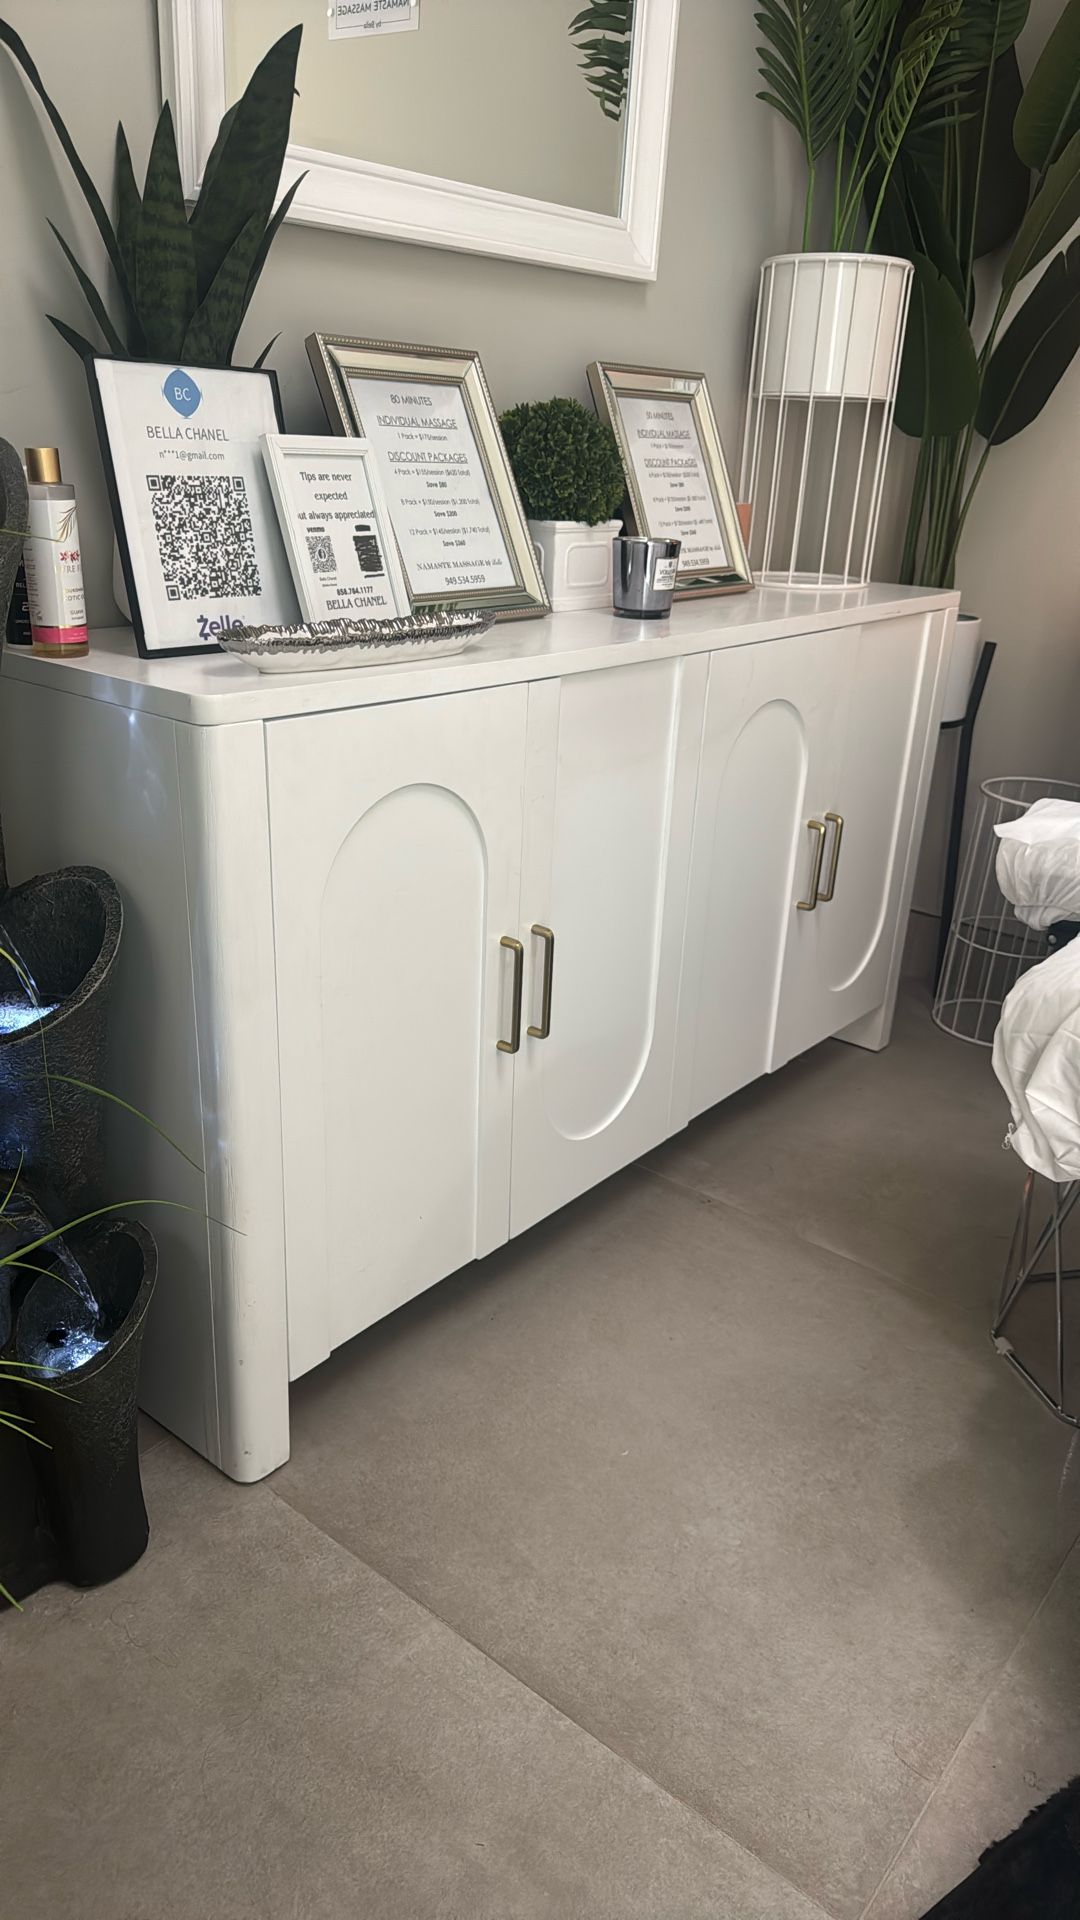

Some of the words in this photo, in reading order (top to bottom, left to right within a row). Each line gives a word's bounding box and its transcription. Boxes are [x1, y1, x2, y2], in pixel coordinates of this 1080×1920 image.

[174, 387, 192, 402] BC
[390, 394, 400, 404] 80
[402, 396, 432, 406] MINUTES
[376, 415, 420, 427] INDIVIDUAL
[421, 418, 458, 430] MASSAGE
[146, 425, 184, 440] BELLA
[185, 427, 230, 442] CHANEL
[388, 451, 427, 462] DISCOUNT
[428, 452, 468, 464] PACKAGES
[300, 472, 316, 483] Tips
[314, 492, 348, 501] expected
[308, 511, 333, 521] always
[335, 510, 375, 522] appreciated
[416, 561, 452, 571] NAMASTE
[452, 560, 485, 568] MASSAGE
[445, 574, 486, 586] 949.534.5959
[326, 599, 353, 610] BELLA
[354, 596, 387, 607] CHANEL
[196, 614, 244, 640] Zelle
